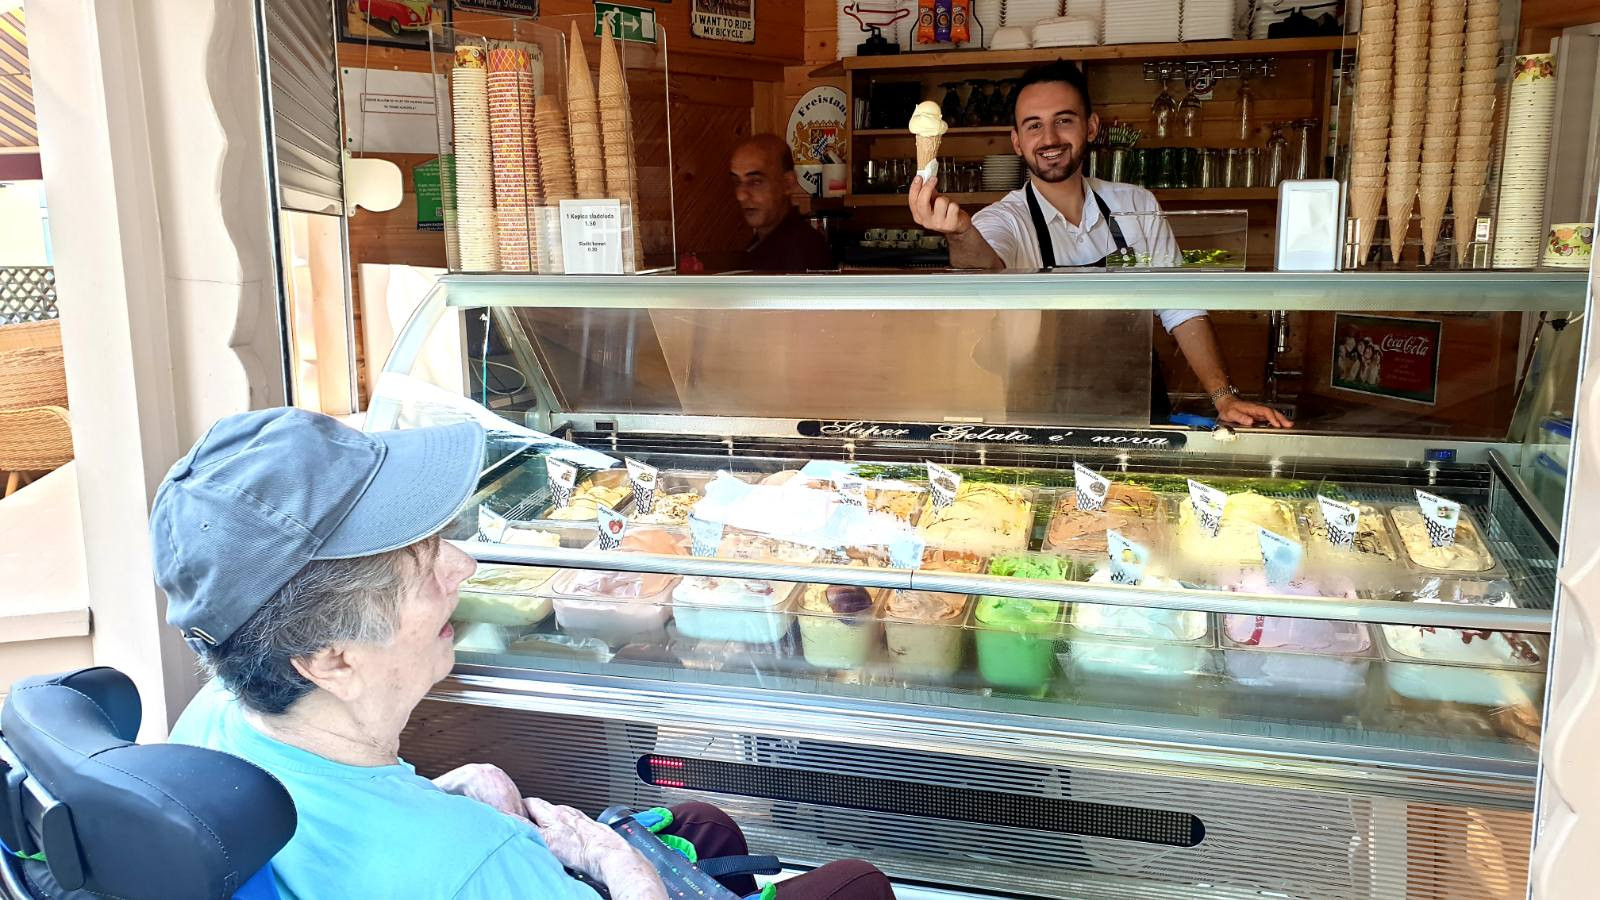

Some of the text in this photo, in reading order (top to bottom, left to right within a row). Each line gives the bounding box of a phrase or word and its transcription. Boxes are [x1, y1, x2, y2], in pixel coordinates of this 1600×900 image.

[694, 14, 752, 30] I WANT TO RIDE
[703, 26, 744, 39] MY BICYCLE
[797, 94, 847, 117] Freistaa
[930, 424, 1033, 441] Gelato
[1090, 434, 1169, 445] nova
